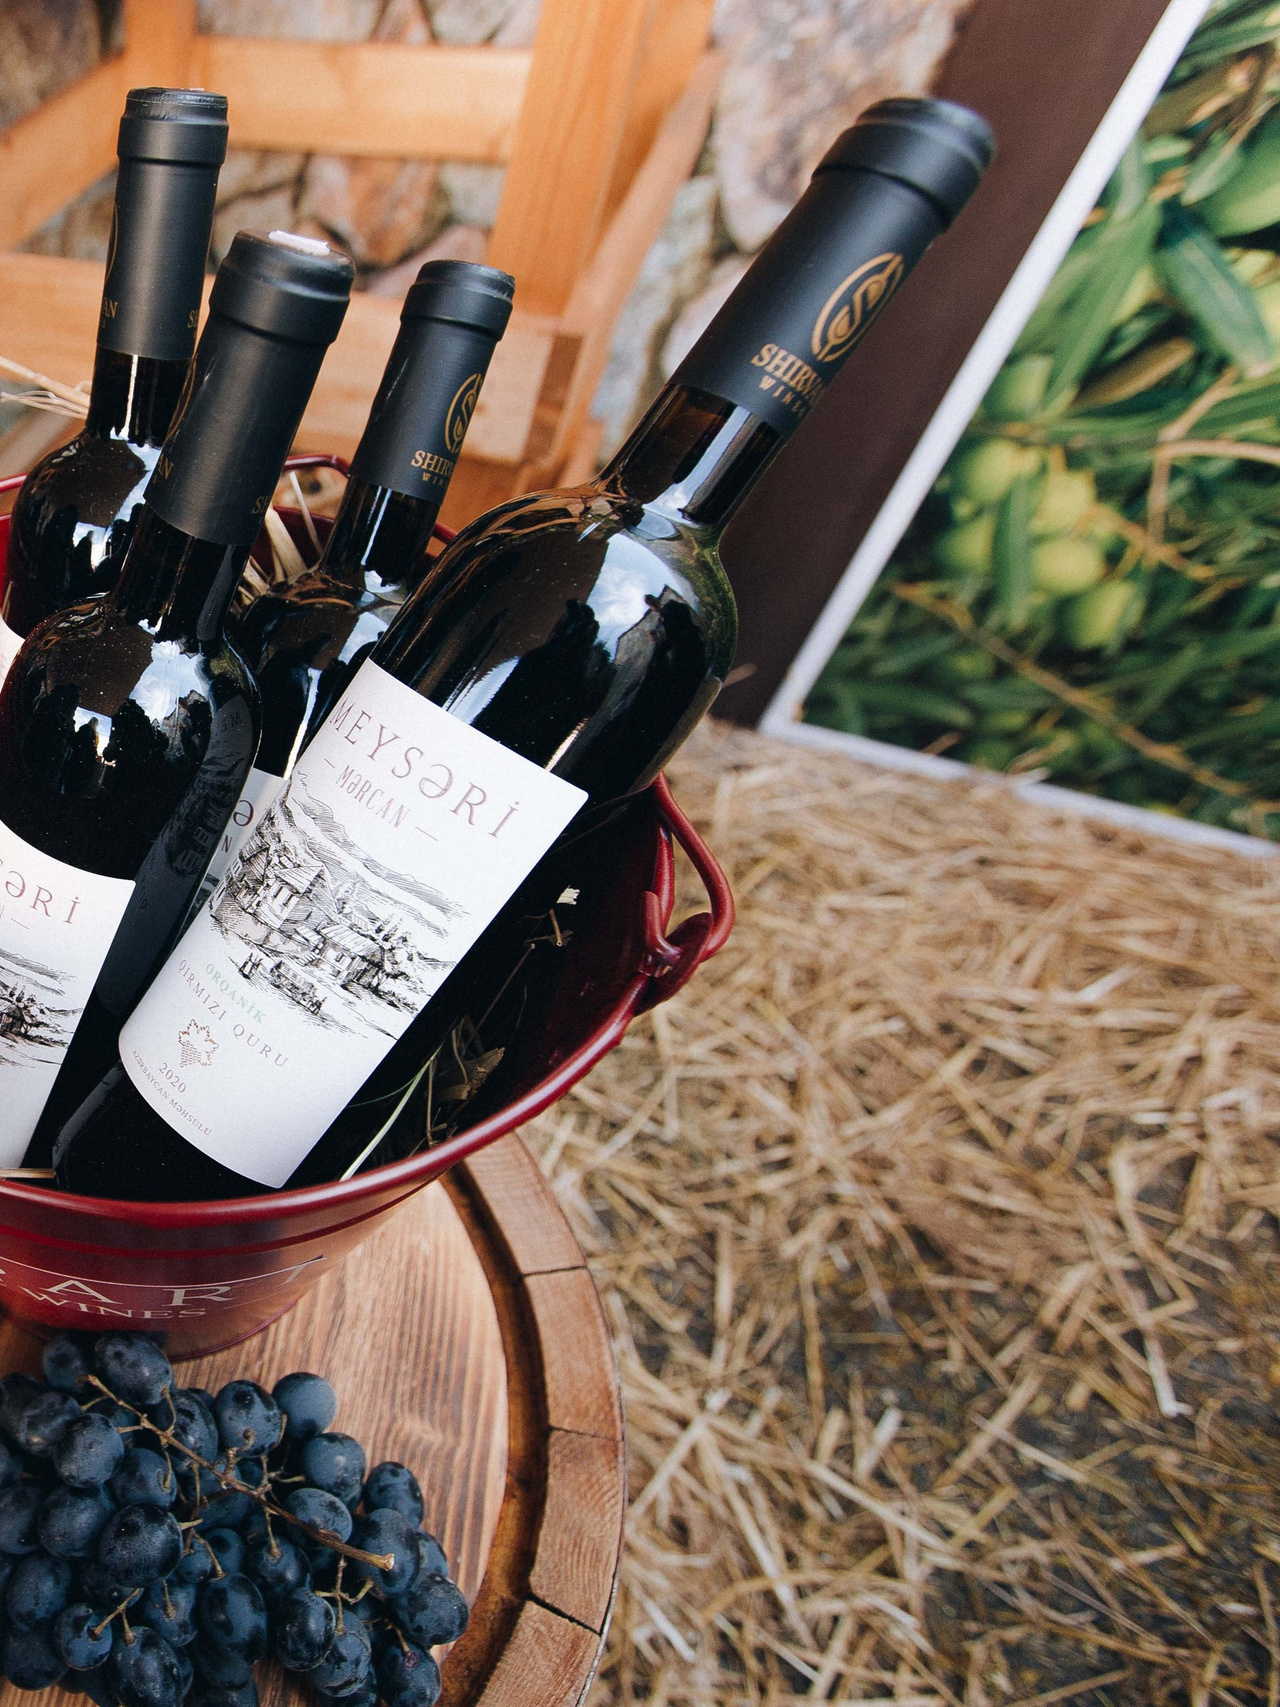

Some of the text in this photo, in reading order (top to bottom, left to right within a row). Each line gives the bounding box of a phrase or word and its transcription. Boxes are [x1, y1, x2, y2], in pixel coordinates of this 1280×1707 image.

[750, 343, 822, 406] SHIRVA
[410, 450, 455, 477] SHIR
[328, 696, 520, 839] MEYSƏRİ
[232, 1023, 289, 1068] QURU
[158, 1062, 188, 1095] 2020
[18, 1285, 207, 1320] WINES
